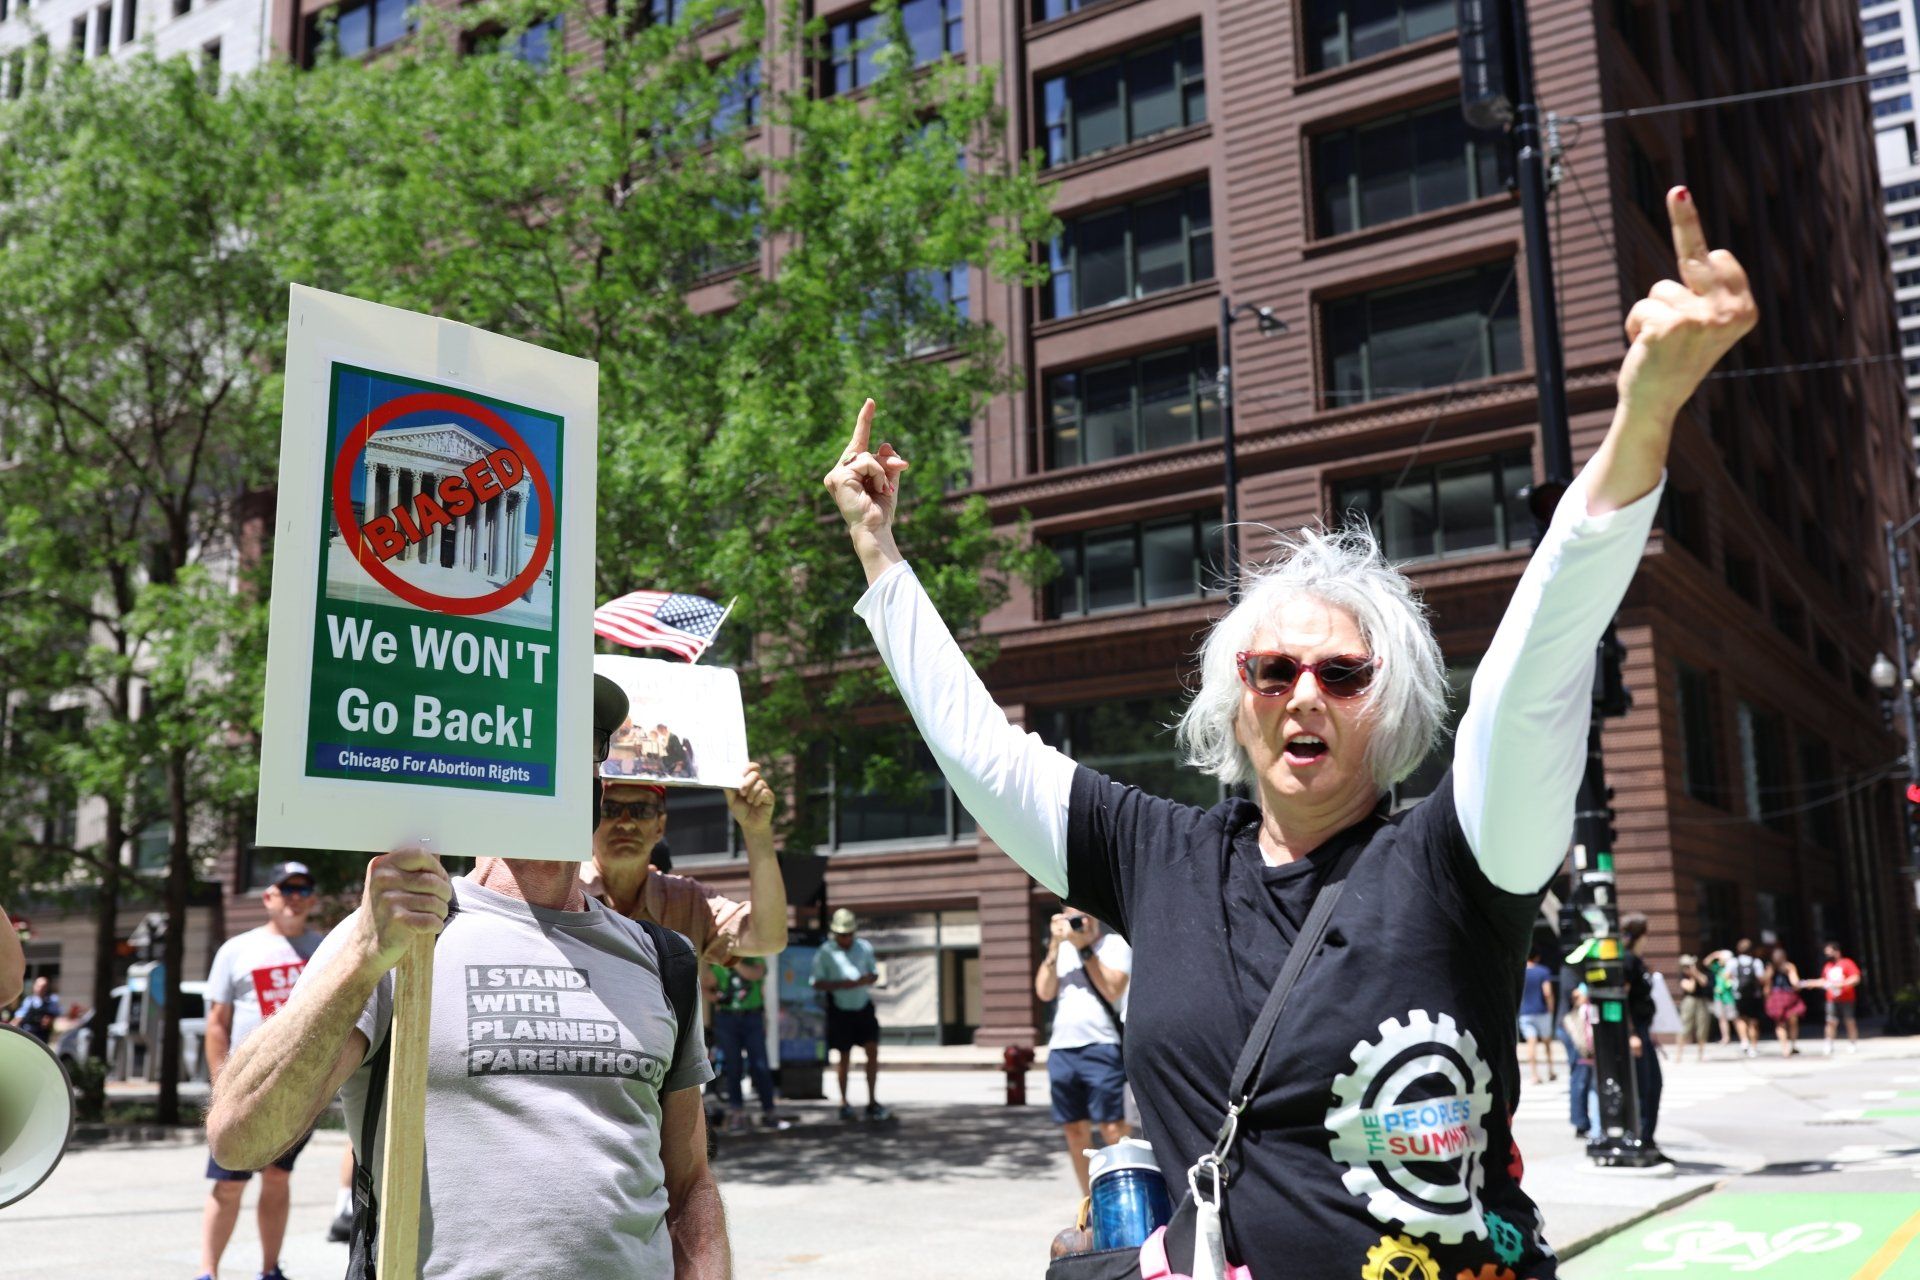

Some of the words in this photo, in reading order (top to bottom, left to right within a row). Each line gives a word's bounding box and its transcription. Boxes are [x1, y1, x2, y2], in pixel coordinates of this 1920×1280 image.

[361, 448, 525, 562] BIASED
[326, 614, 398, 664] We
[410, 624, 550, 684] WON'T
[336, 687, 399, 735] Go
[412, 694, 533, 749] Back!
[338, 750, 399, 772] Chicago
[402, 756, 427, 772] For
[428, 758, 485, 778] Abortion
[488, 764, 530, 782] Rights
[269, 965, 305, 989] SA
[469, 968, 479, 987] I
[487, 968, 587, 989] STAND
[472, 994, 556, 1013] WITH
[472, 1020, 617, 1043] PLANNED
[472, 1050, 664, 1083] PARENTHOOD
[1362, 1115, 1386, 1155] THE
